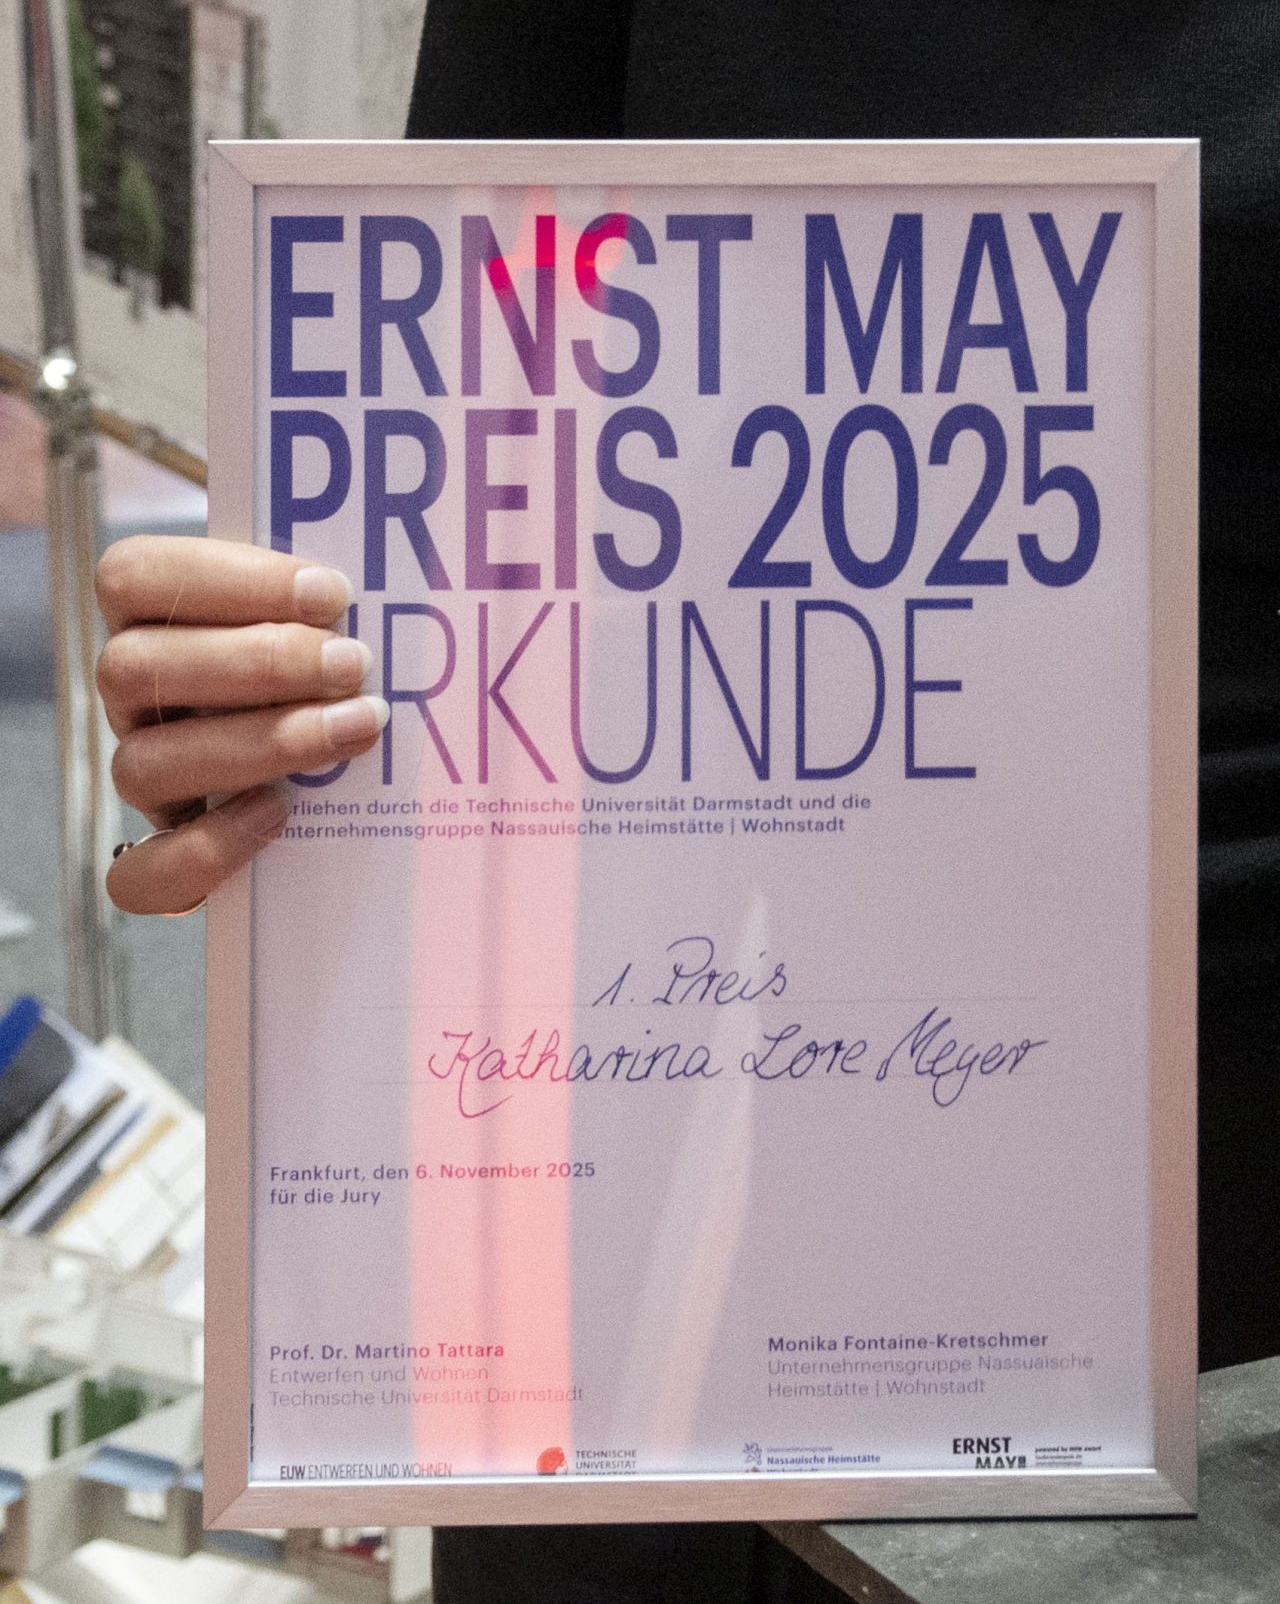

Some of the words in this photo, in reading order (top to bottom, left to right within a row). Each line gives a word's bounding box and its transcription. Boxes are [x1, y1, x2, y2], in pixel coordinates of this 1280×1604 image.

[269, 212, 753, 399] ERNST
[804, 211, 1123, 396] MAY
[269, 406, 683, 592] PREIS
[727, 403, 1103, 590] 2025
[288, 799, 360, 815] rliehen
[366, 798, 424, 815] durch
[429, 798, 460, 814] die
[466, 797, 575, 814] Technische
[581, 796, 686, 813] Universität
[692, 794, 794, 811] Darmstadt
[799, 794, 836, 810] und
[841, 793, 872, 809] die
[278, 821, 486, 840] nternehmensgruppe
[490, 818, 612, 836] Nassauische
[618, 817, 725, 835] Heimstätte
[741, 816, 846, 834] Wohnstadt
[593, 962, 636, 1007] 1.
[651, 936, 789, 1006] Preis
[428, 1028, 724, 1119] Katharina
[741, 1023, 869, 1082] Lore
[875, 1007, 1048, 1107] Meyer
[269, 1164, 367, 1182] Frankfurt,
[373, 1164, 409, 1180] den
[415, 1163, 434, 1179] 6.
[440, 1162, 540, 1179] November
[546, 1162, 596, 1178] 2025
[269, 1187, 298, 1205] für
[303, 1187, 335, 1204] die
[339, 1187, 382, 1207] Jury
[269, 1345, 315, 1361] Prof.
[321, 1344, 348, 1361] Dr.
[354, 1343, 431, 1359] Martino
[436, 1342, 505, 1359] Tattara
[767, 1335, 839, 1352] Monika
[843, 1333, 1050, 1352] Fontaine-Kretschmer
[269, 1366, 365, 1384] Entwerfen
[370, 1366, 407, 1382] und
[413, 1365, 490, 1382] Wohnen
[767, 1356, 974, 1376] Unternehmensgruppe
[269, 1389, 375, 1408] Technische
[486, 1386, 583, 1403] Darmstadt
[767, 1380, 870, 1398] Heimstätte
[886, 1378, 986, 1395] Wohnstadt
[575, 1449, 638, 1459] TECHNISCHE
[952, 1437, 1013, 1454] ERNST
[766, 1454, 826, 1465] Nassauische
[279, 1465, 306, 1480] EUW
[307, 1464, 373, 1480] ENTWERFEN
[375, 1464, 400, 1479] UND
[401, 1462, 453, 1478] WOHNEN
